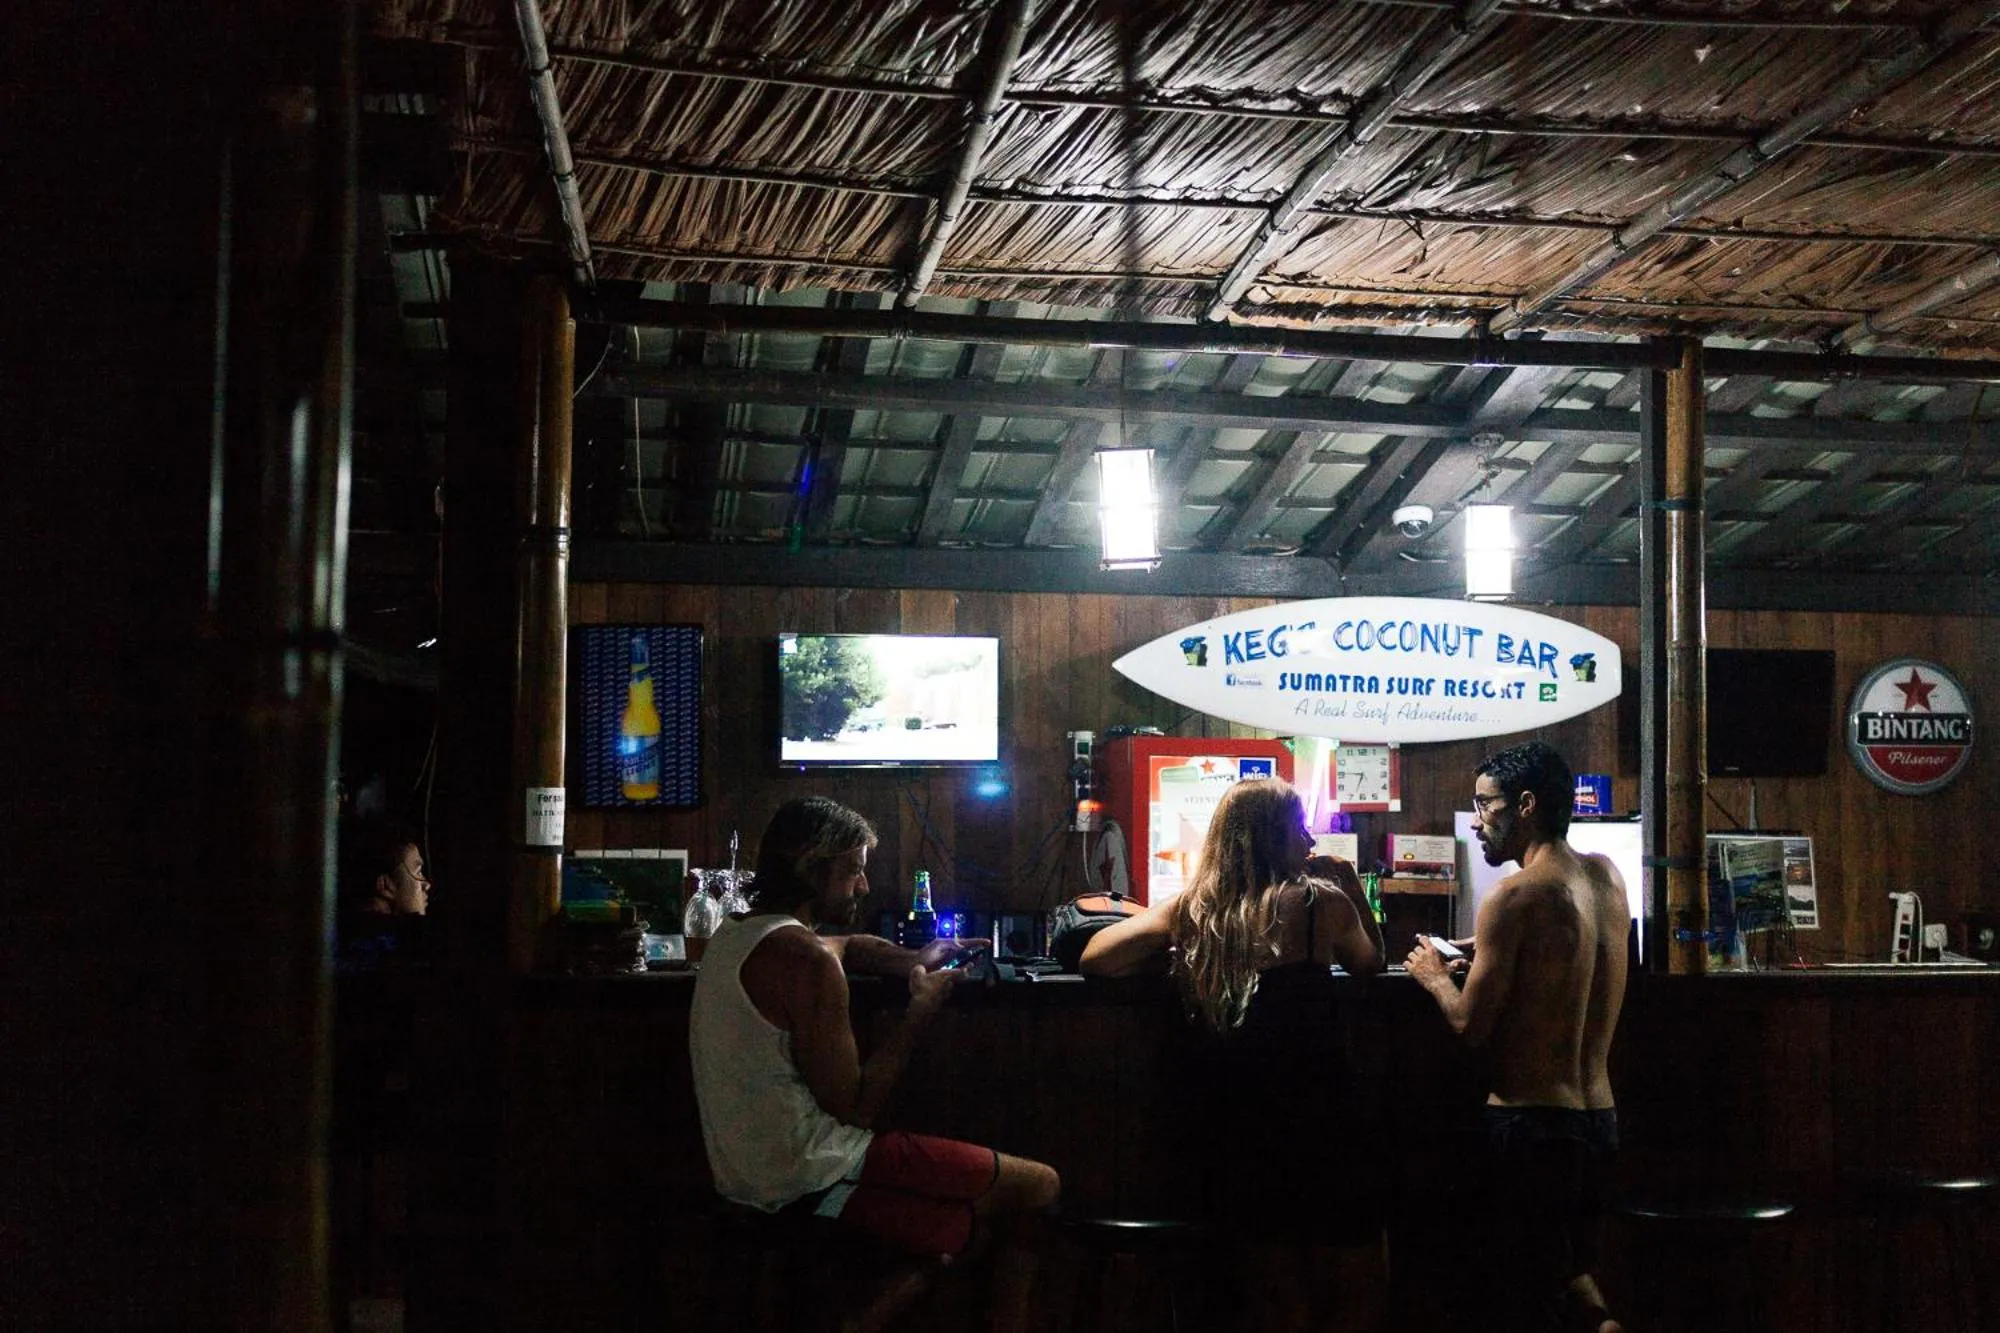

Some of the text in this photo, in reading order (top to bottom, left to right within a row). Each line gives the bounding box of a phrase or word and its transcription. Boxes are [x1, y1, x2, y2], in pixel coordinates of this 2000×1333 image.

[1332, 619, 1484, 659] COCONUT
[1496, 632, 1559, 679] BAR
[1278, 672, 1380, 695] SUMATRA
[1386, 676, 1436, 696] SURF
[1294, 698, 1309, 716] A
[1313, 698, 1347, 718] Real
[1352, 700, 1390, 726] Surf
[1866, 718, 1964, 740] BINTANG
[1888, 751, 1948, 766] Pilsener
